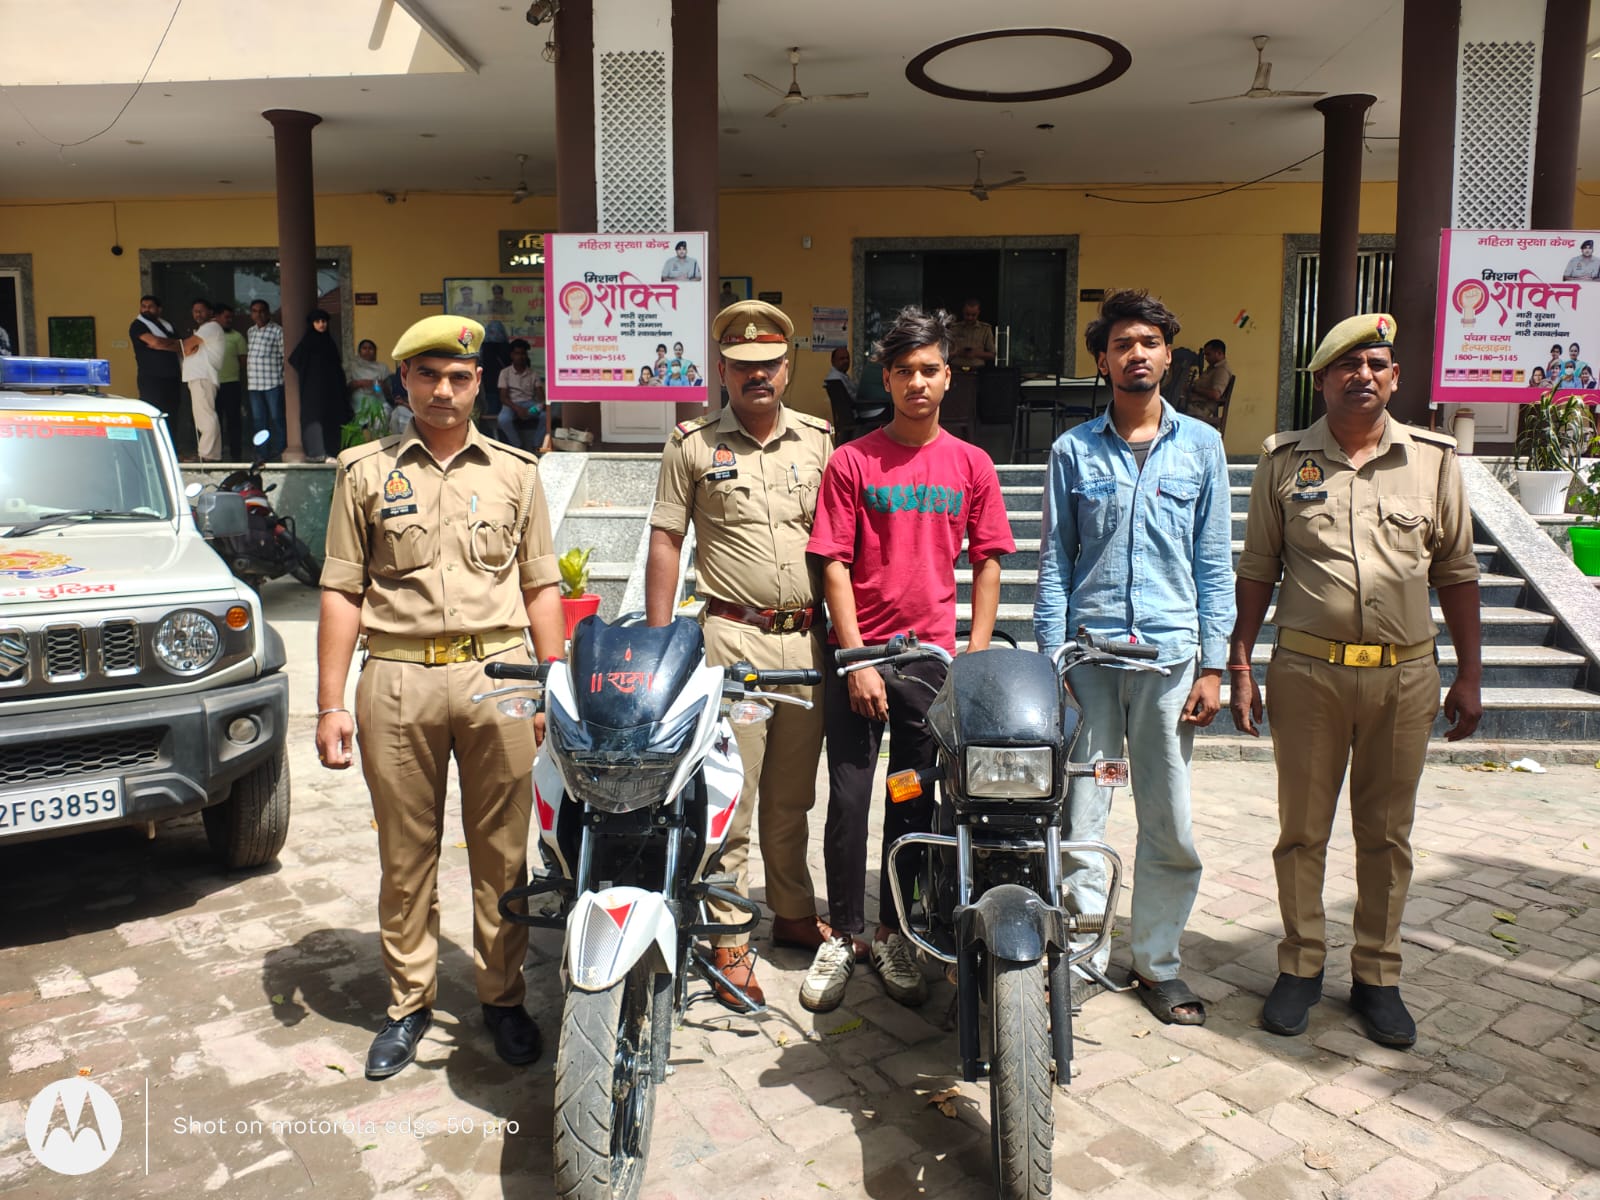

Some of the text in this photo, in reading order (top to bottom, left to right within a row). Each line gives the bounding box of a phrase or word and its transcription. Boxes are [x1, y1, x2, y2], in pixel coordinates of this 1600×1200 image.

[578, 238, 670, 253] महिला सुरक्षा केन्द्र
[1478, 235, 1576, 250] महिला सुरक्षा केन्द्र
[584, 271, 618, 283] मिशन
[1481, 268, 1518, 281] मिशन
[594, 271, 680, 327] शक्ति
[1490, 269, 1582, 327] शक्ति
[1464, 332, 1487, 342] पंचम
[37, 583, 115, 599] पुलिस
